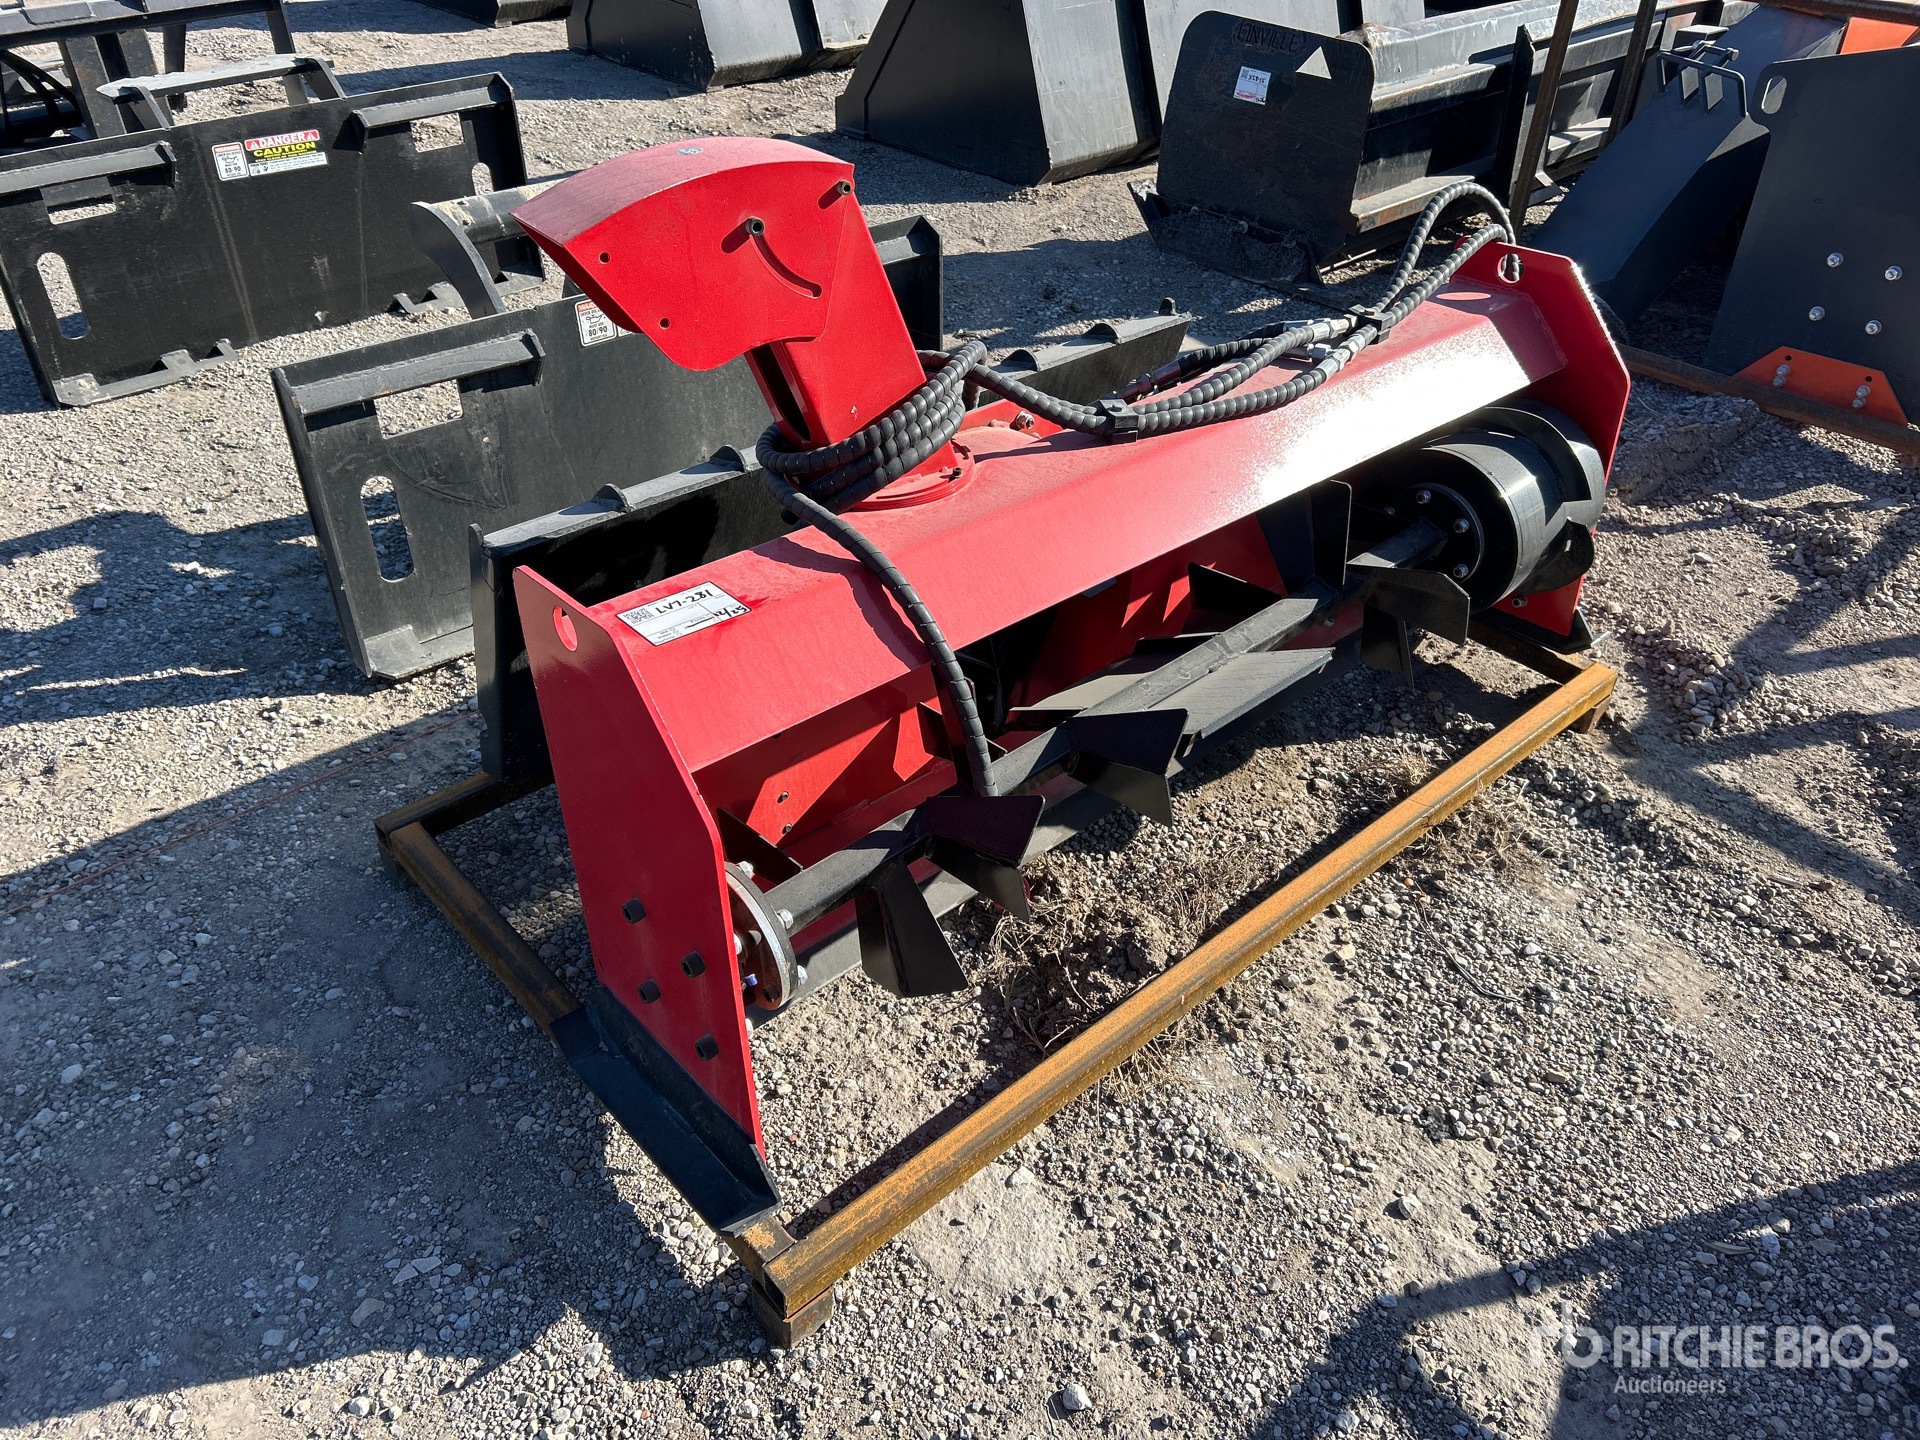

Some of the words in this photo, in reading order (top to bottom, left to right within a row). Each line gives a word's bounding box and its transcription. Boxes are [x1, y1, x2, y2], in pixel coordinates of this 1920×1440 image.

[260, 133, 305, 147] DANGER
[253, 142, 316, 156] CAUTION
[589, 325, 608, 337] 80/90
[655, 589, 713, 614] LV7-281
